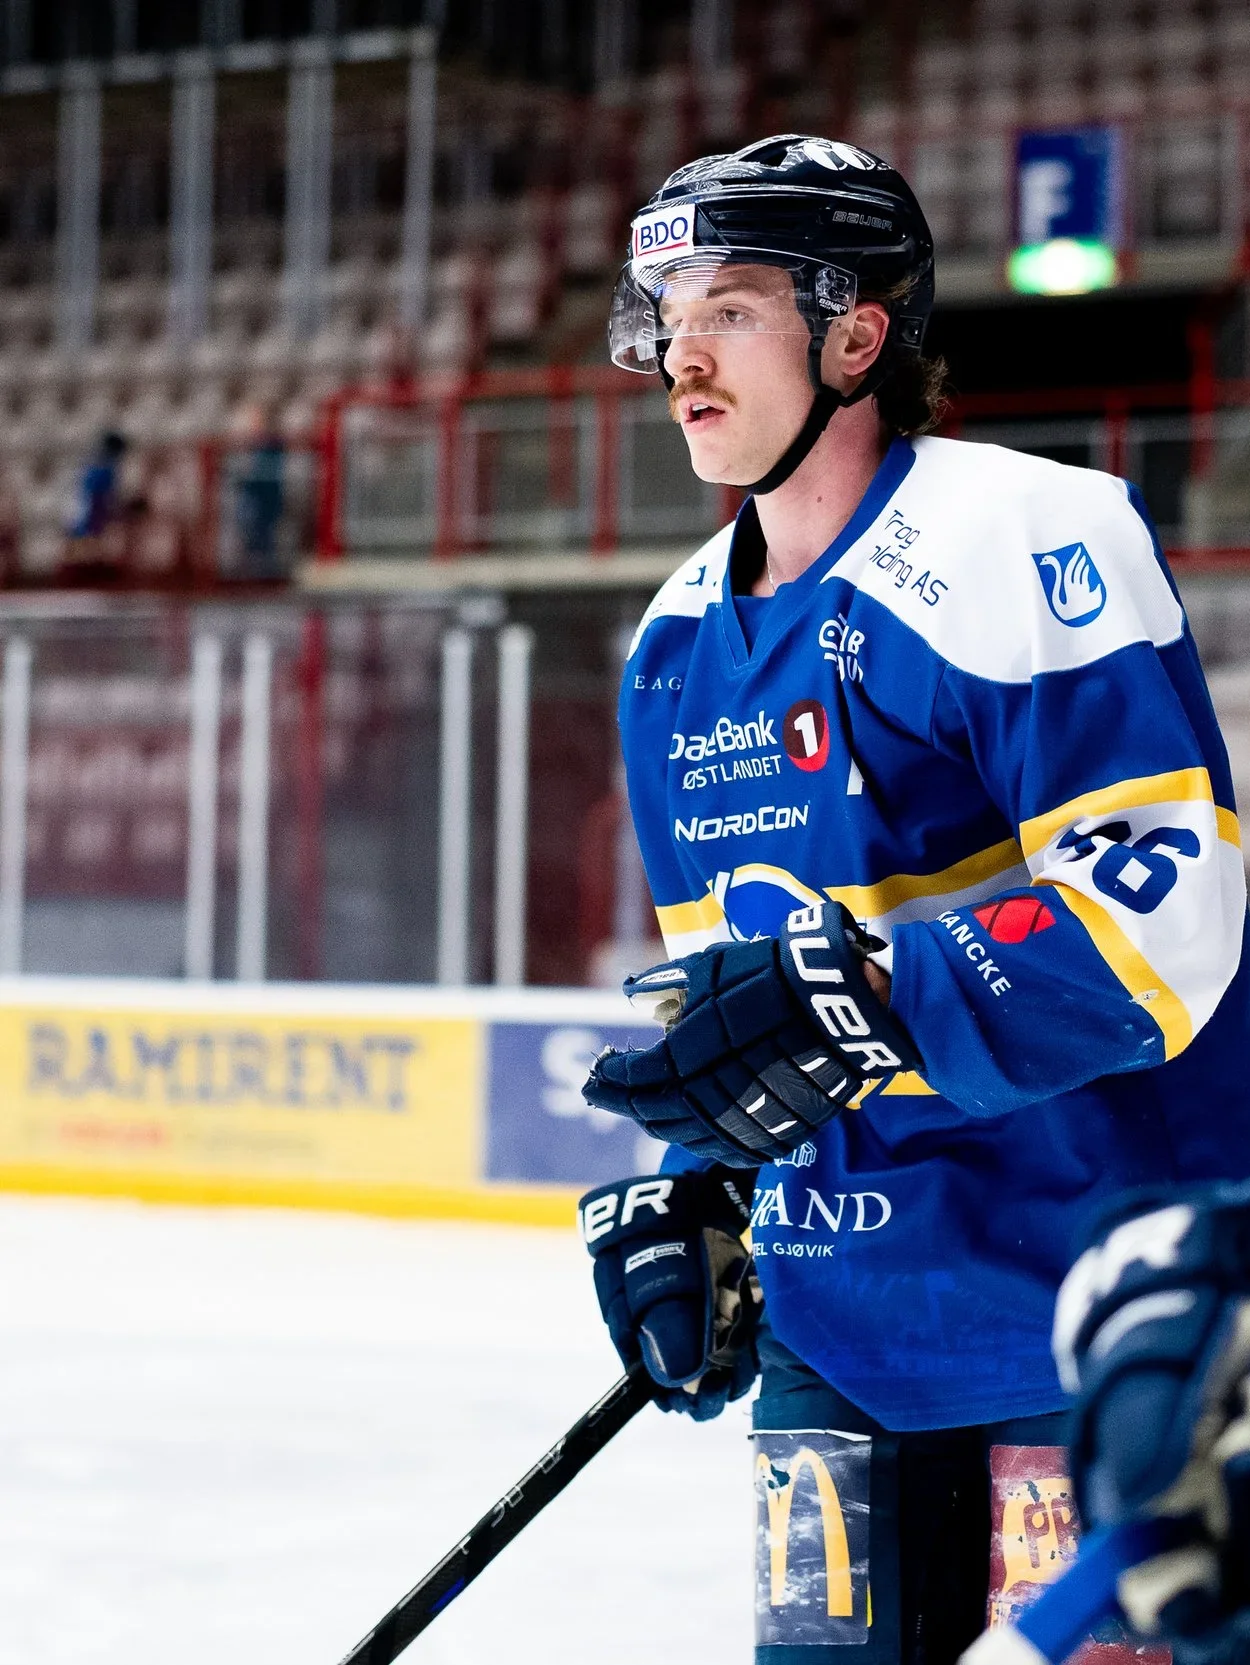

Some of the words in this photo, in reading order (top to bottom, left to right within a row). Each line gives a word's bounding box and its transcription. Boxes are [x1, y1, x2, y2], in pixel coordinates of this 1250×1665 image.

[832, 210, 893, 232] BAUER
[1020, 158, 1074, 247] F
[640, 216, 689, 250] BDO
[868, 545, 913, 588] lding
[910, 570, 949, 606] AS
[793, 711, 819, 758] 1
[682, 754, 782, 790] ØSTLANDET
[27, 1022, 420, 1113] RAMIRENT
[750, 1182, 892, 1233] RAND
[772, 1242, 835, 1258] GJØVIK
